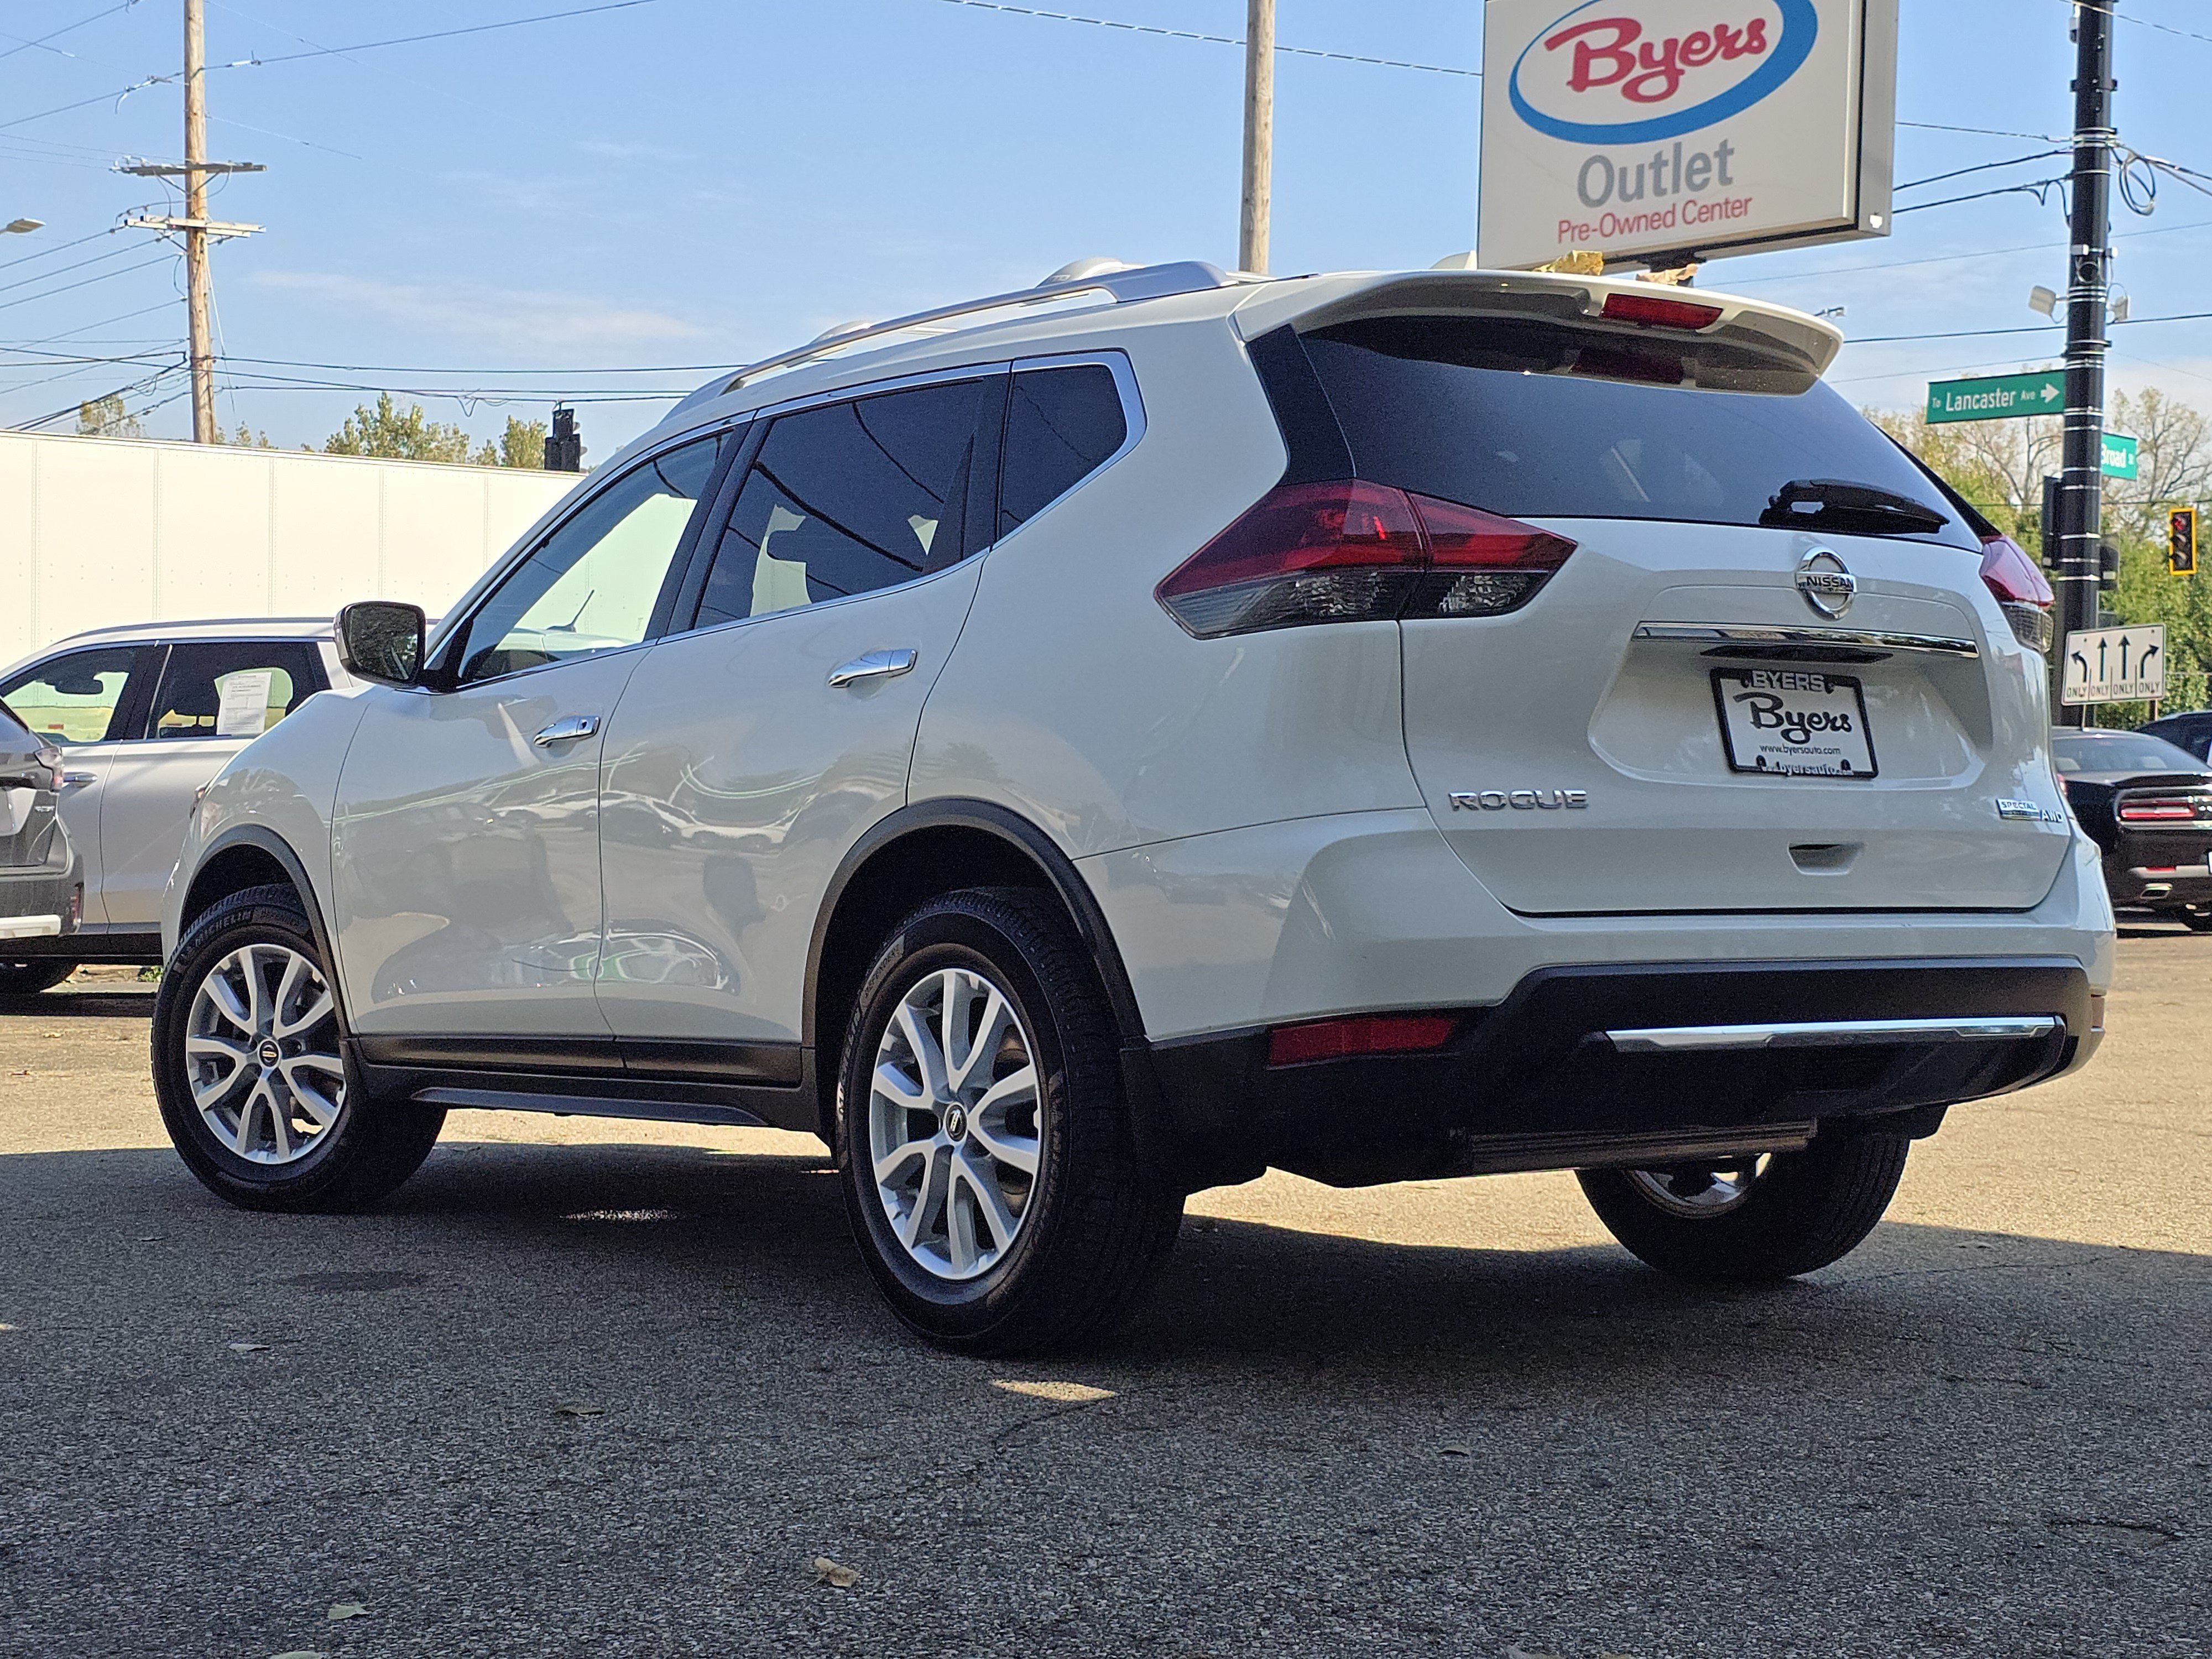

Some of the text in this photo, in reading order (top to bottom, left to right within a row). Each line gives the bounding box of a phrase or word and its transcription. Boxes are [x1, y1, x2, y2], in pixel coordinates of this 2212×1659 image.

[1544, 17, 1767, 103] Byers
[1577, 139, 1735, 208] Outlet
[1557, 196, 1753, 244] Pre-Owned Center
[1932, 387, 2036, 412] To Lancaster Ave
[1806, 576, 1854, 589] NISSAN
[1751, 670, 1825, 691] BYERS
[2066, 681, 2161, 698] ONLY ONLY ONLY ONLY
[1733, 691, 1853, 744] Byers
[1759, 743, 1841, 756] www.byersauto.com
[1448, 790, 1589, 811] ROGUE
[2001, 801, 2037, 810] SPECIAL
[2041, 809, 2064, 823] AWD
